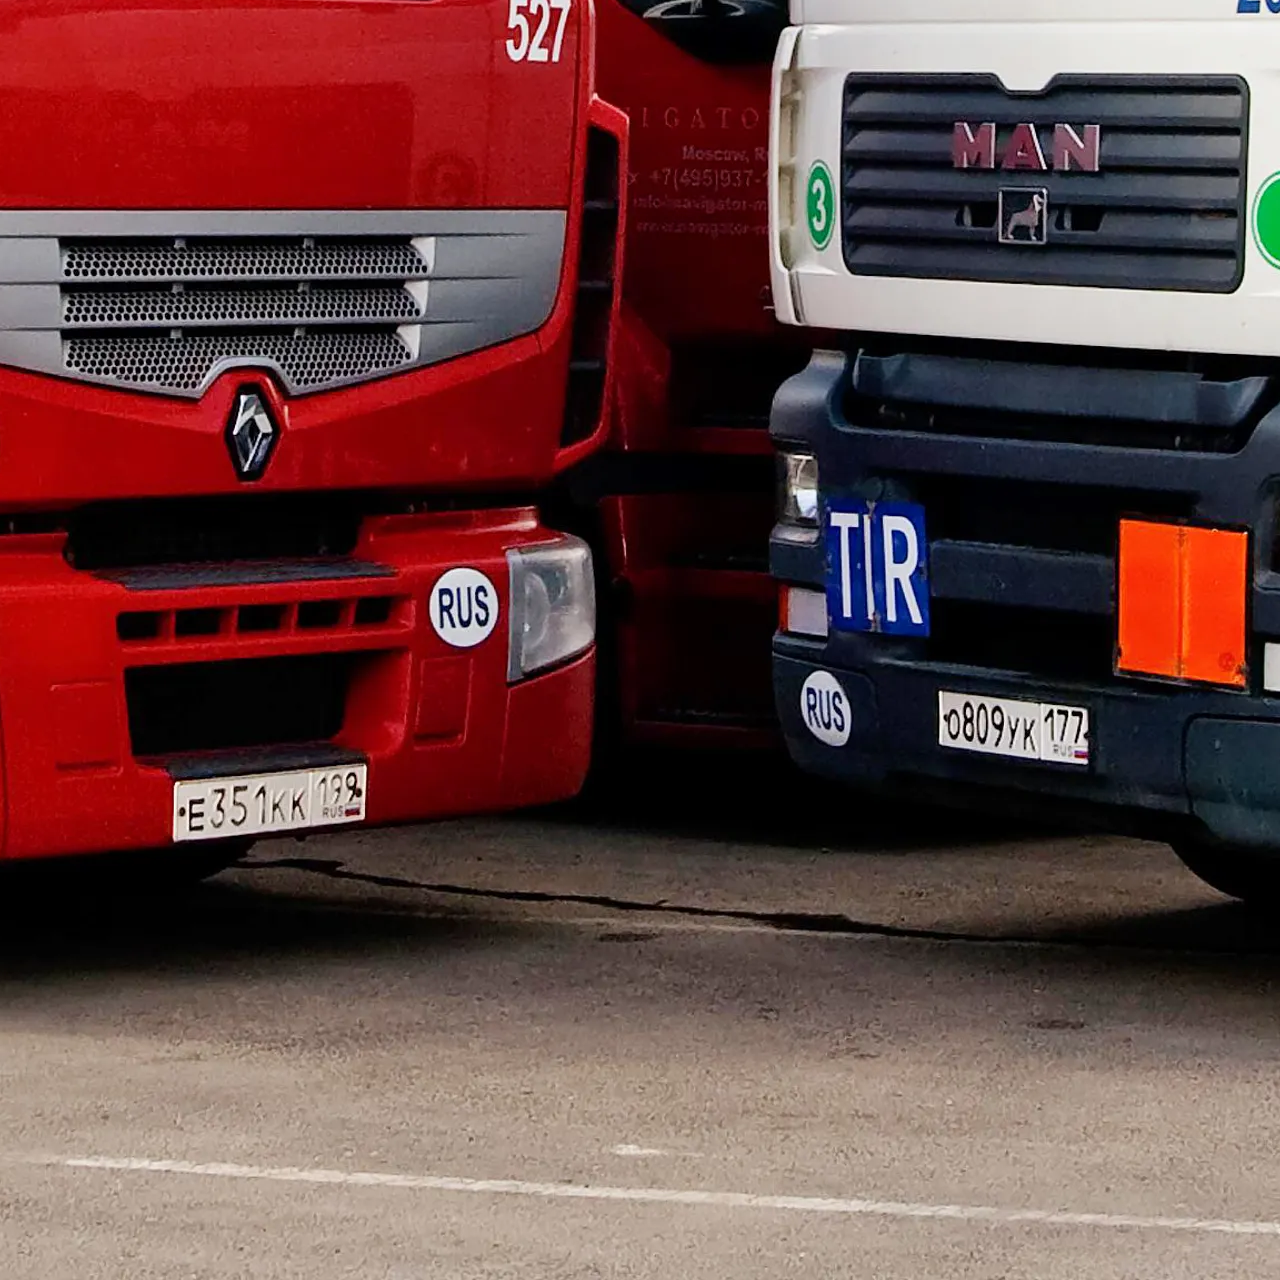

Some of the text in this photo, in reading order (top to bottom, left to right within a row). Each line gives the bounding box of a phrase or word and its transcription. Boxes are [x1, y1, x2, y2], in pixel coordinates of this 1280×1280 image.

[951, 121, 1101, 173] MAN
[811, 178, 828, 232] 3
[830, 511, 924, 625] TIR
[437, 584, 491, 630] RUS
[806, 685, 846, 734] RUS
[1044, 708, 1084, 744] 177
[316, 771, 359, 804] 199
[322, 806, 344, 819] RUS
